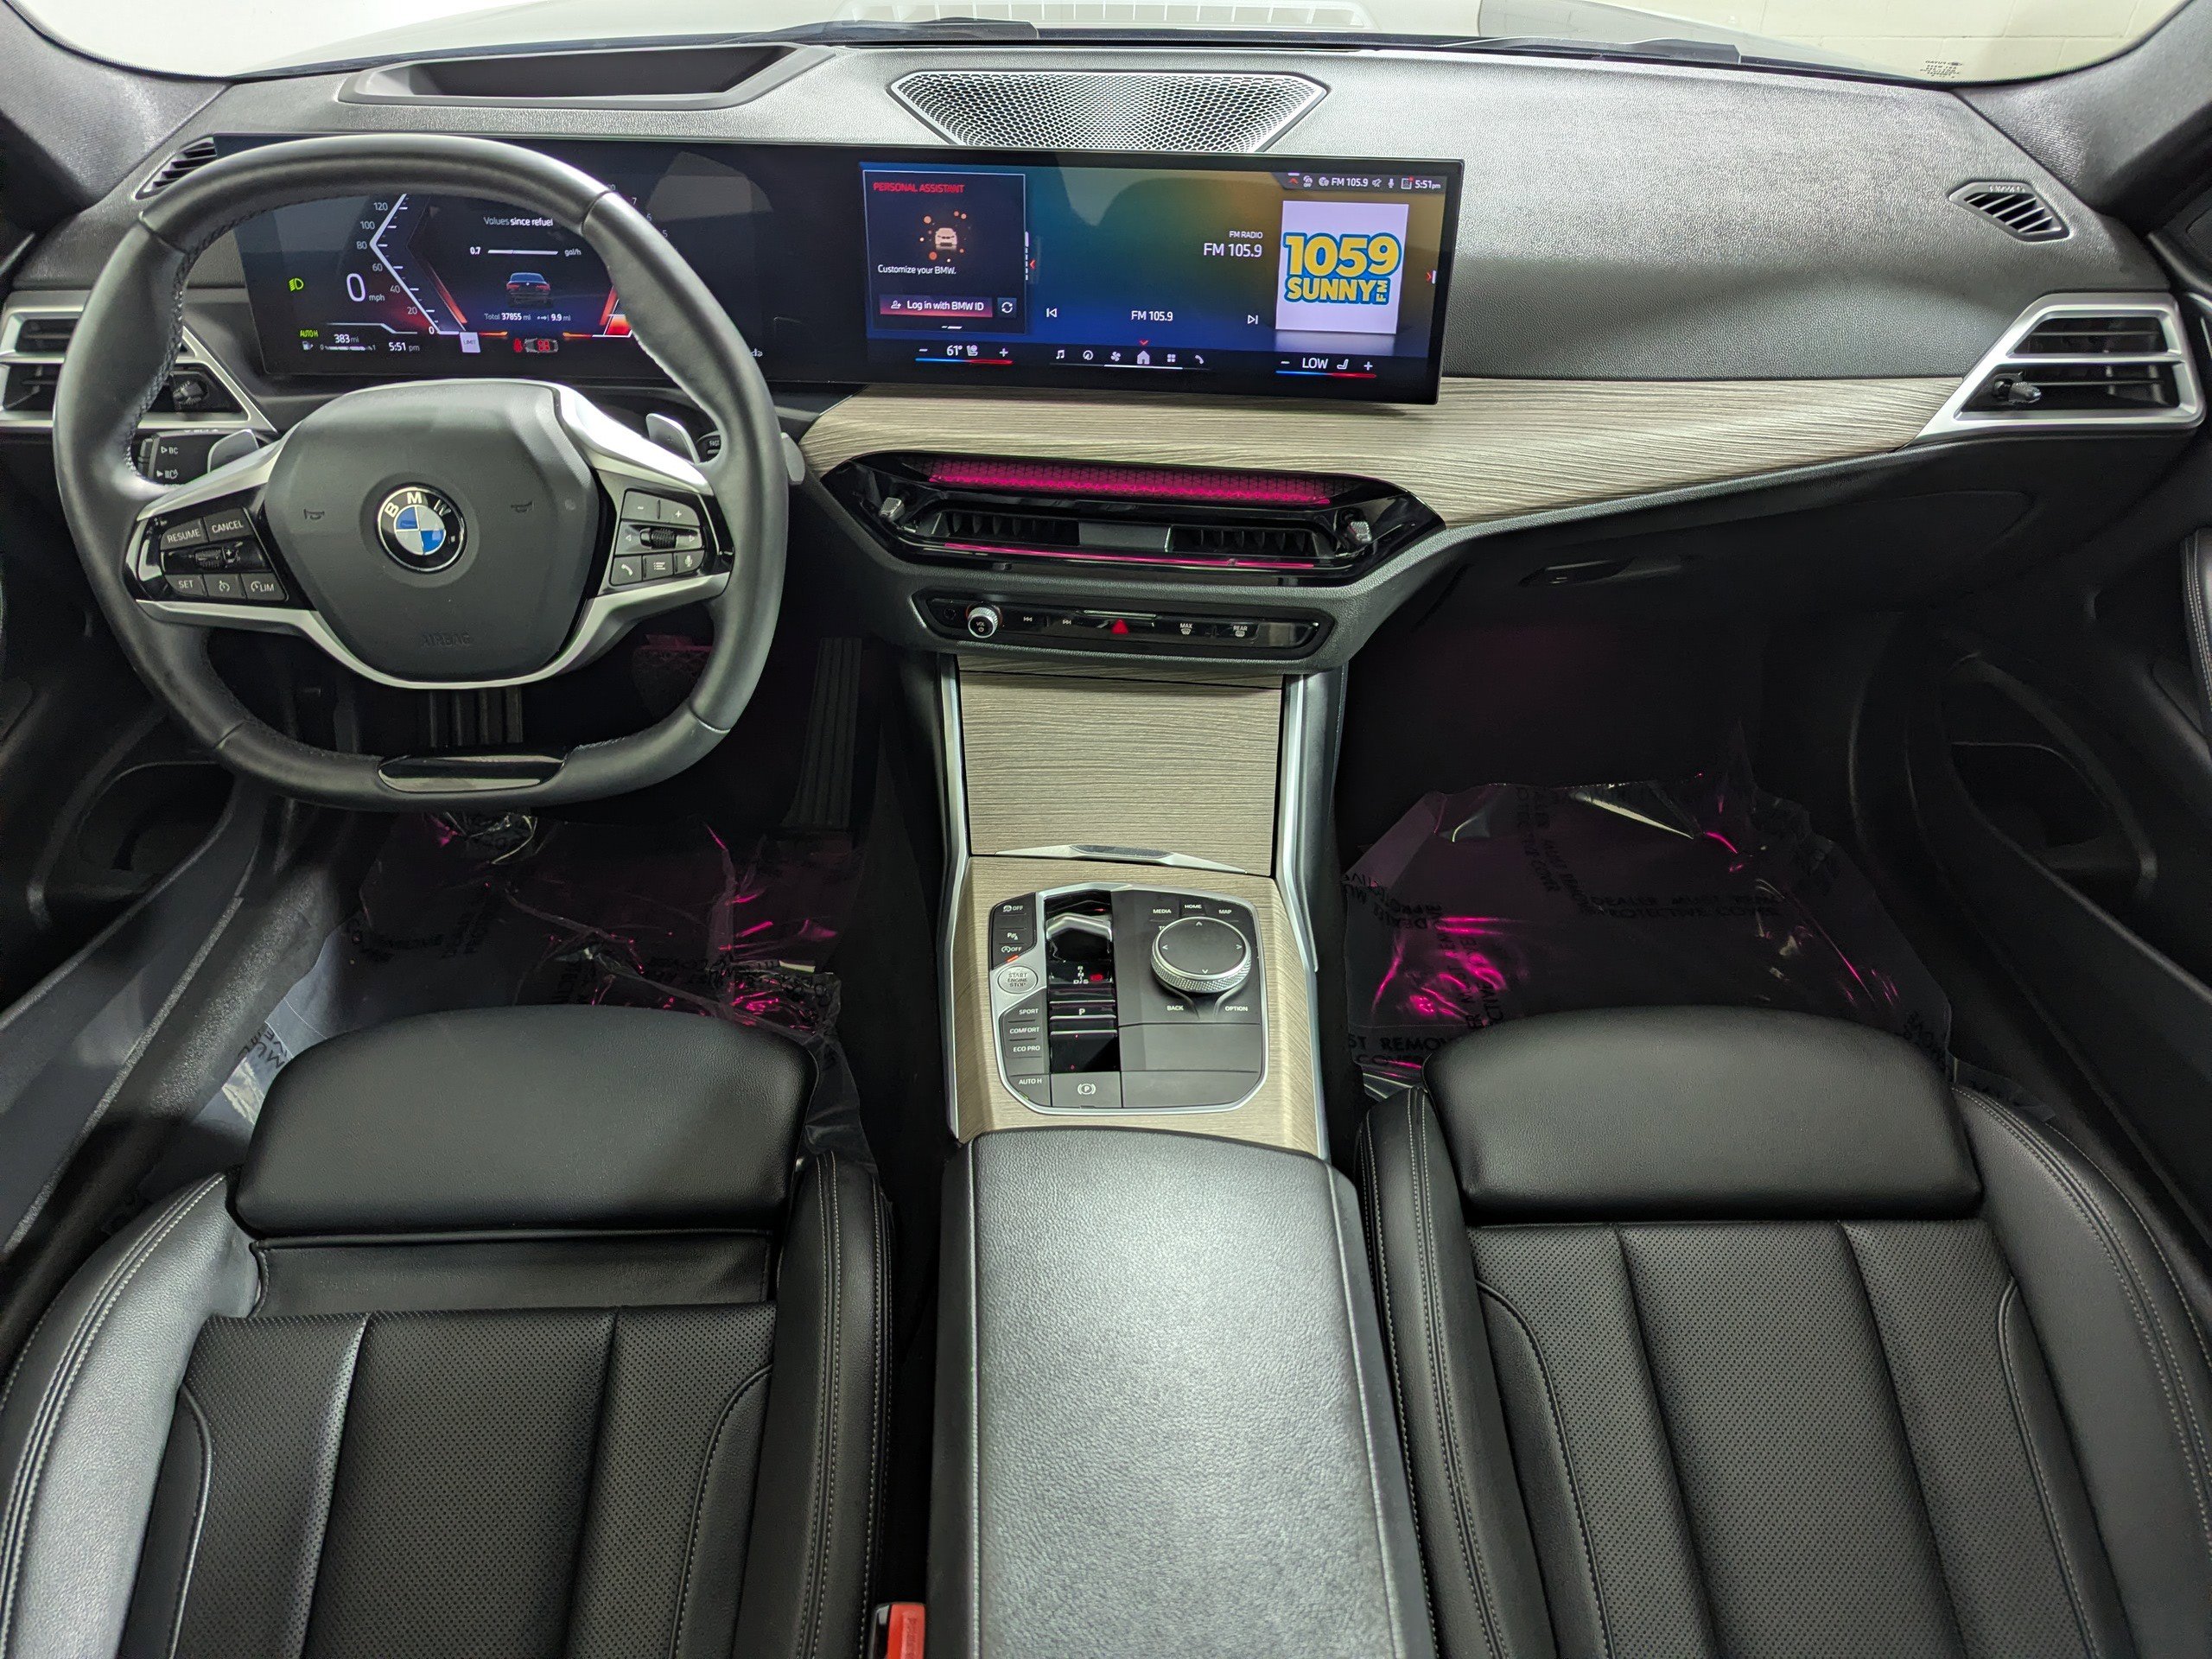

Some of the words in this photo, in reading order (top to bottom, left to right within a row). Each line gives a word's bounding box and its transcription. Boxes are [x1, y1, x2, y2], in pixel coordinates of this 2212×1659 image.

[873, 181, 918, 192] PERSONAL
[919, 183, 965, 194] ASSISTANT
[1331, 178, 1344, 187] FM
[1346, 178, 1369, 188] 105.9
[373, 202, 389, 211] 120
[360, 221, 376, 230] 100
[484, 217, 510, 226] Values
[510, 217, 531, 226] since
[531, 217, 553, 227] refuel
[1241, 231, 1263, 239] RADIO
[357, 241, 368, 250] 80
[469, 246, 481, 255] 0.7
[1204, 243, 1224, 257] FM
[1228, 244, 1262, 257] 105.9
[372, 264, 383, 272] 60
[877, 264, 916, 274] Customize
[918, 267, 933, 276] your
[934, 266, 957, 275] BMW.
[346, 272, 366, 302] 0
[369, 293, 385, 303] mph
[390, 284, 401, 294] 40
[1284, 276, 1376, 303] SUNNY
[1376, 279, 1389, 303] FM
[407, 306, 417, 315] 20
[906, 301, 923, 312] Log
[924, 301, 932, 310] in
[933, 301, 950, 311] with
[951, 302, 974, 311] BMW
[975, 302, 984, 311] ID
[550, 313, 563, 321] 9.9
[1131, 310, 1147, 321] FM
[1148, 310, 1173, 321] 105.9
[429, 326, 435, 335] 0
[334, 334, 350, 344] 383
[388, 341, 406, 352] 5:51
[1302, 357, 1328, 369] LOW
[385, 492, 452, 518] BMW
[212, 520, 244, 533] CANCEL
[167, 529, 201, 543] RESUME
[178, 581, 194, 589] SET
[260, 583, 275, 592] LIM
[1009, 1027, 1039, 1035] COMFORT
